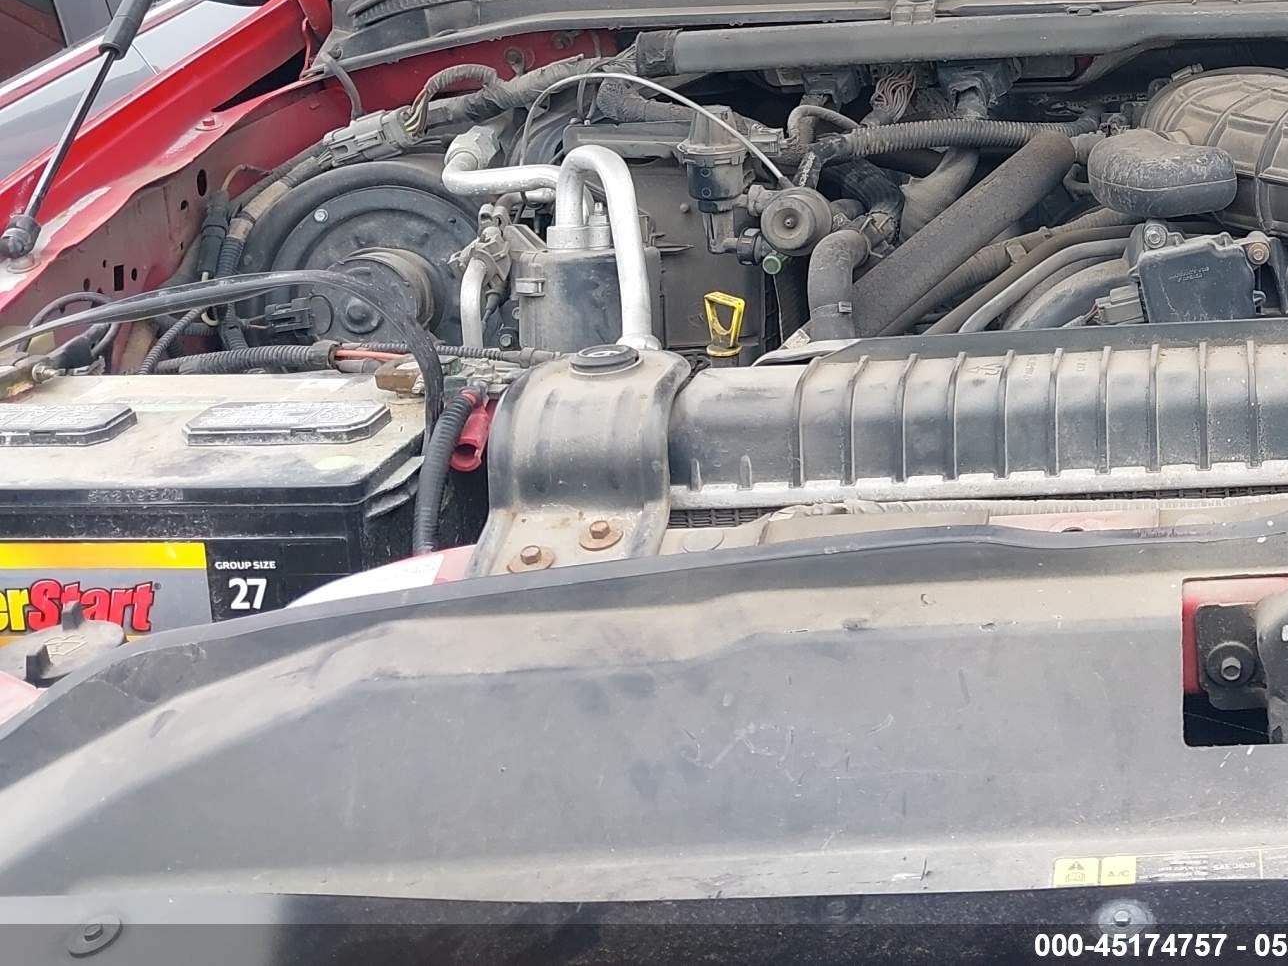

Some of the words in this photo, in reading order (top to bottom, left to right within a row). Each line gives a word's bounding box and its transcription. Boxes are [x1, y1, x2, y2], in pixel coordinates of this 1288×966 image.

[215, 561, 251, 570] GROUP
[253, 561, 277, 569] SIZE
[228, 577, 267, 610] 27
